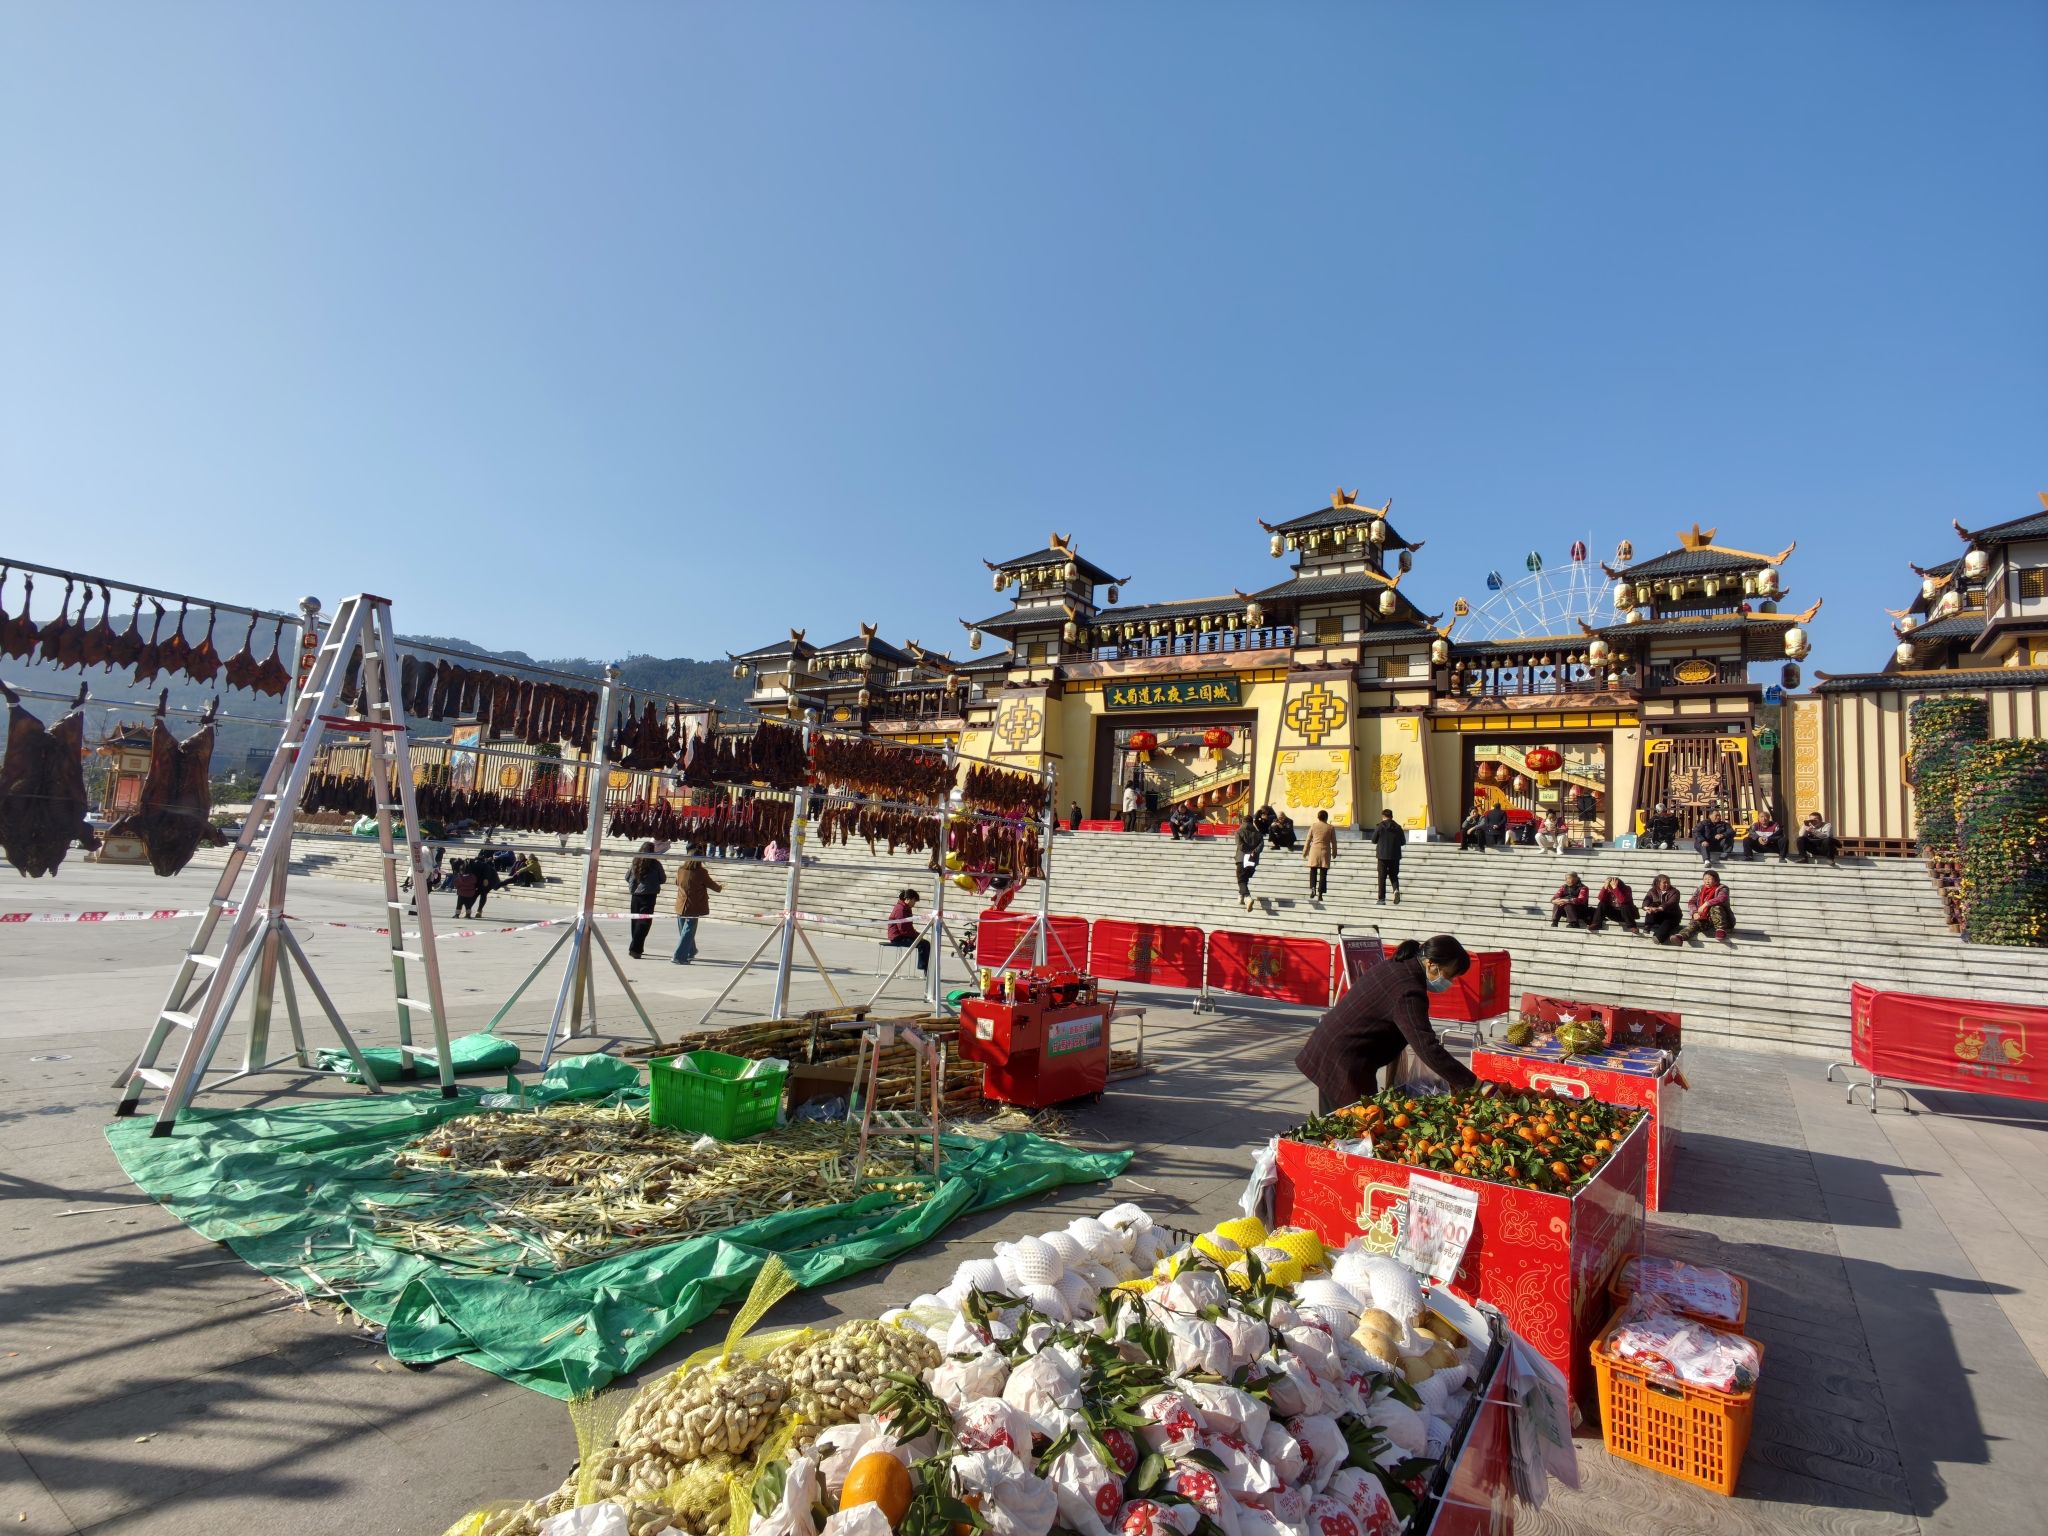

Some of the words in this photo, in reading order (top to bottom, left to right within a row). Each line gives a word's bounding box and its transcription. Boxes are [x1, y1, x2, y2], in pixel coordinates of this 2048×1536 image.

[1113, 683, 1231, 705] 大蜀道不夜三国城
